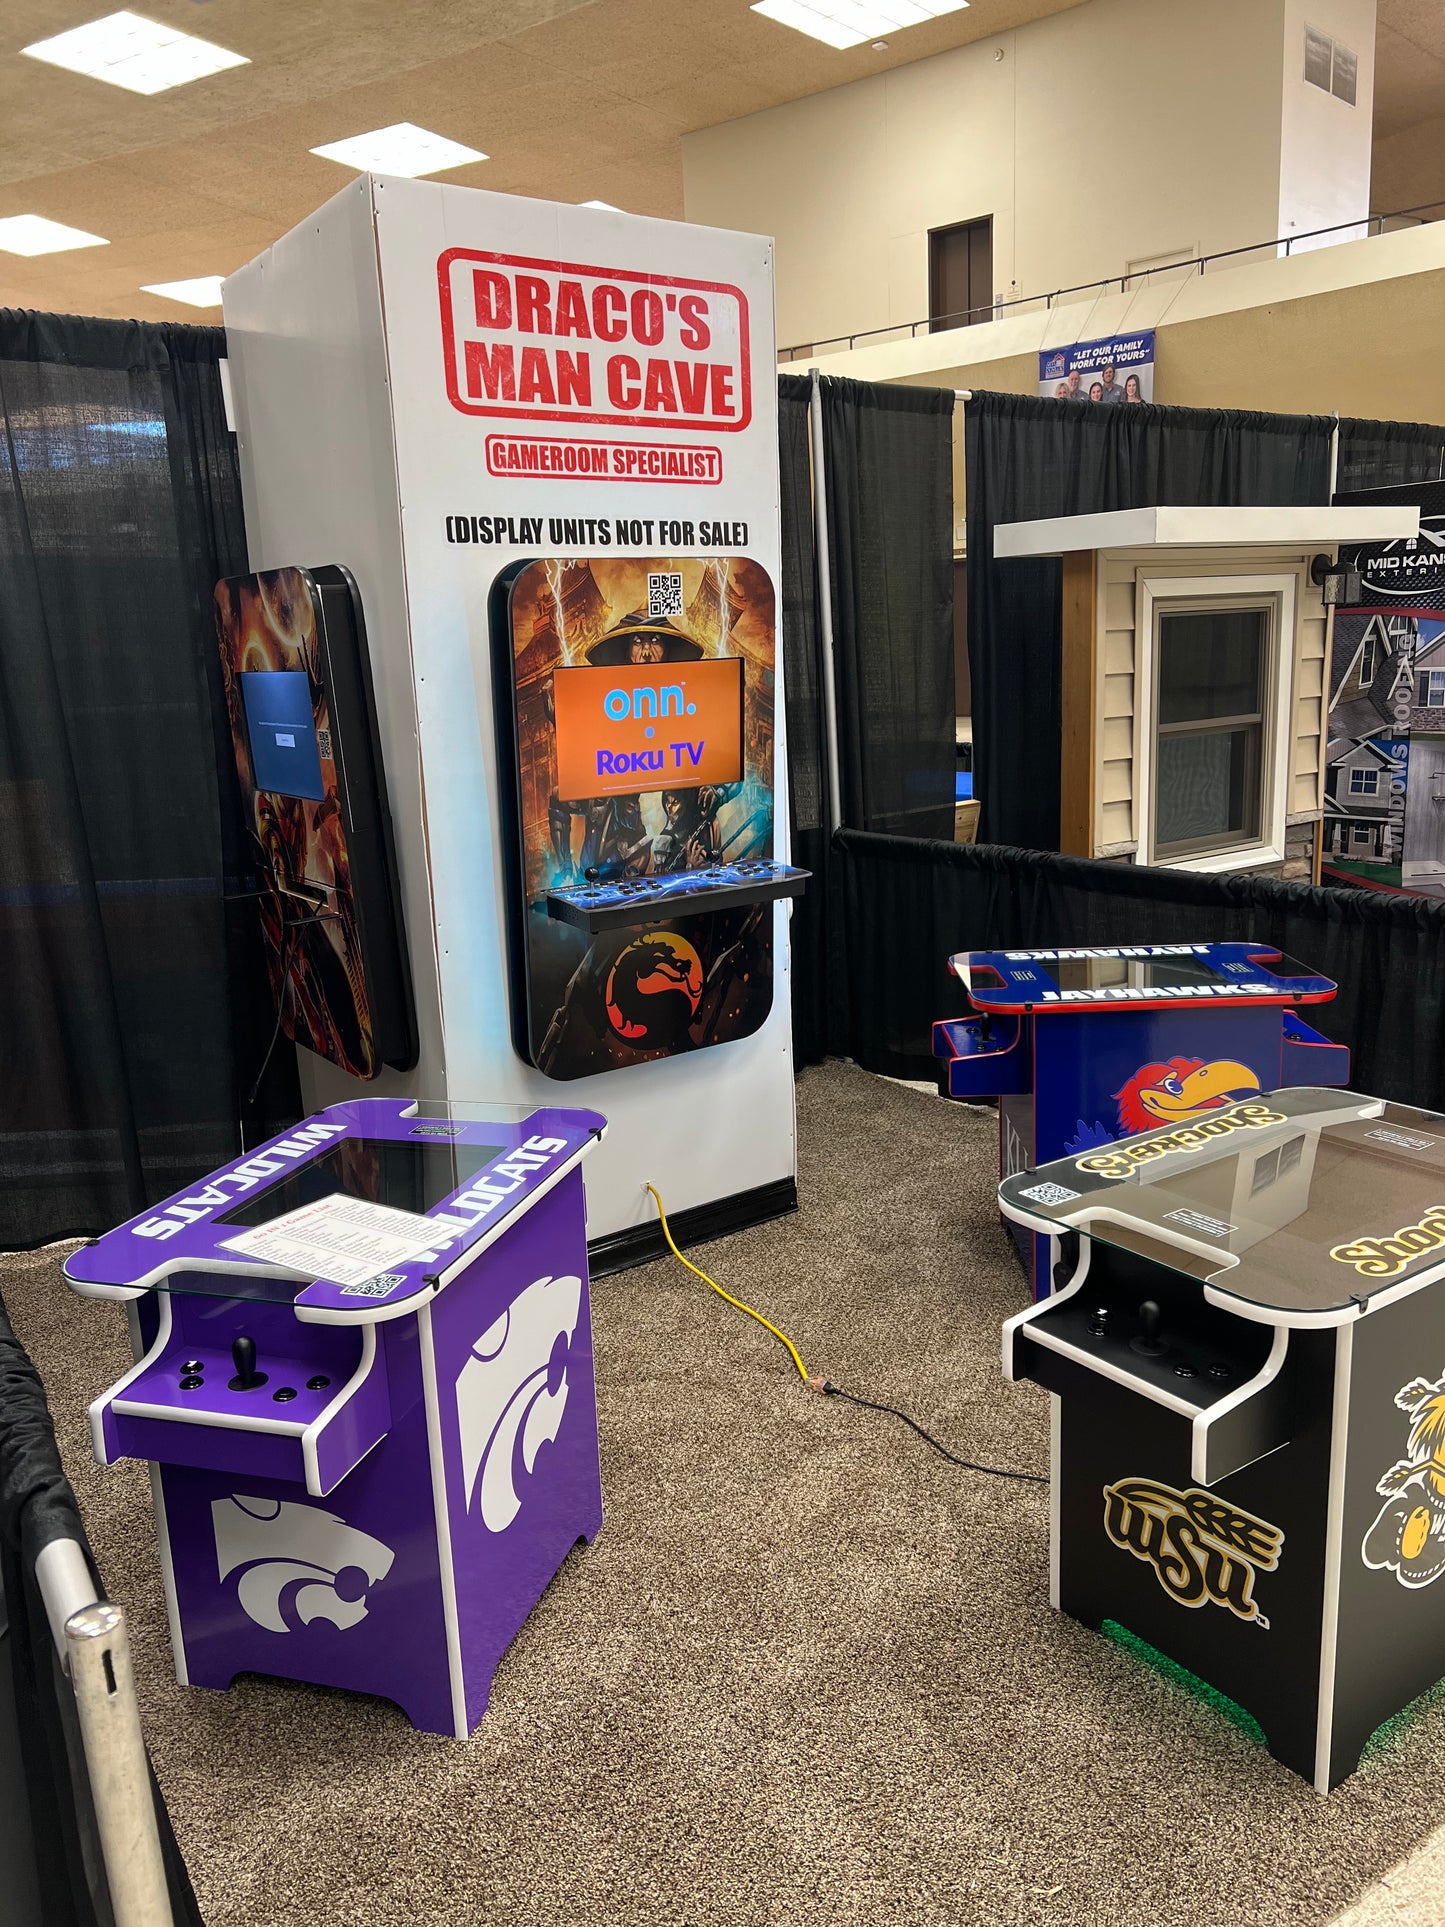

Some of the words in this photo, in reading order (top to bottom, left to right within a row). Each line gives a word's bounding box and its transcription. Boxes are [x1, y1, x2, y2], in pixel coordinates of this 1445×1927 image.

[472, 268, 711, 351] DRACO'S
[1069, 358, 1095, 370] WORK
[1096, 355, 1114, 366] FOR
[1092, 346, 1112, 357] OUR
[1113, 340, 1144, 353] FAMILY
[464, 340, 592, 407] MAN
[606, 354, 736, 417] CAVE
[492, 442, 609, 474] GAMEROOM
[613, 448, 716, 478] SPECIALIST
[446, 515, 543, 545] (DISPLAY
[548, 518, 611, 545] UNITS
[616, 519, 655, 545] NOT
[659, 520, 695, 546] FOR
[700, 521, 748, 547] SALE)
[1366, 567, 1438, 578] EXTERI
[1367, 557, 1400, 570] MID
[1402, 553, 1445, 568] KAN
[604, 684, 697, 721] onn.
[1393, 634, 1416, 736] ROOFING
[670, 741, 705, 768] TV
[1387, 743, 1408, 853] WINDOWS
[1004, 945, 1211, 961] JAYHAWKS
[1042, 983, 1275, 1001] JAYHAWKS
[1075, 1104, 1289, 1179] Shockers
[130, 1123, 349, 1241] WILDCATS
[405, 1135, 569, 1264] LDCATS
[1329, 1205, 1445, 1278] Shoc
